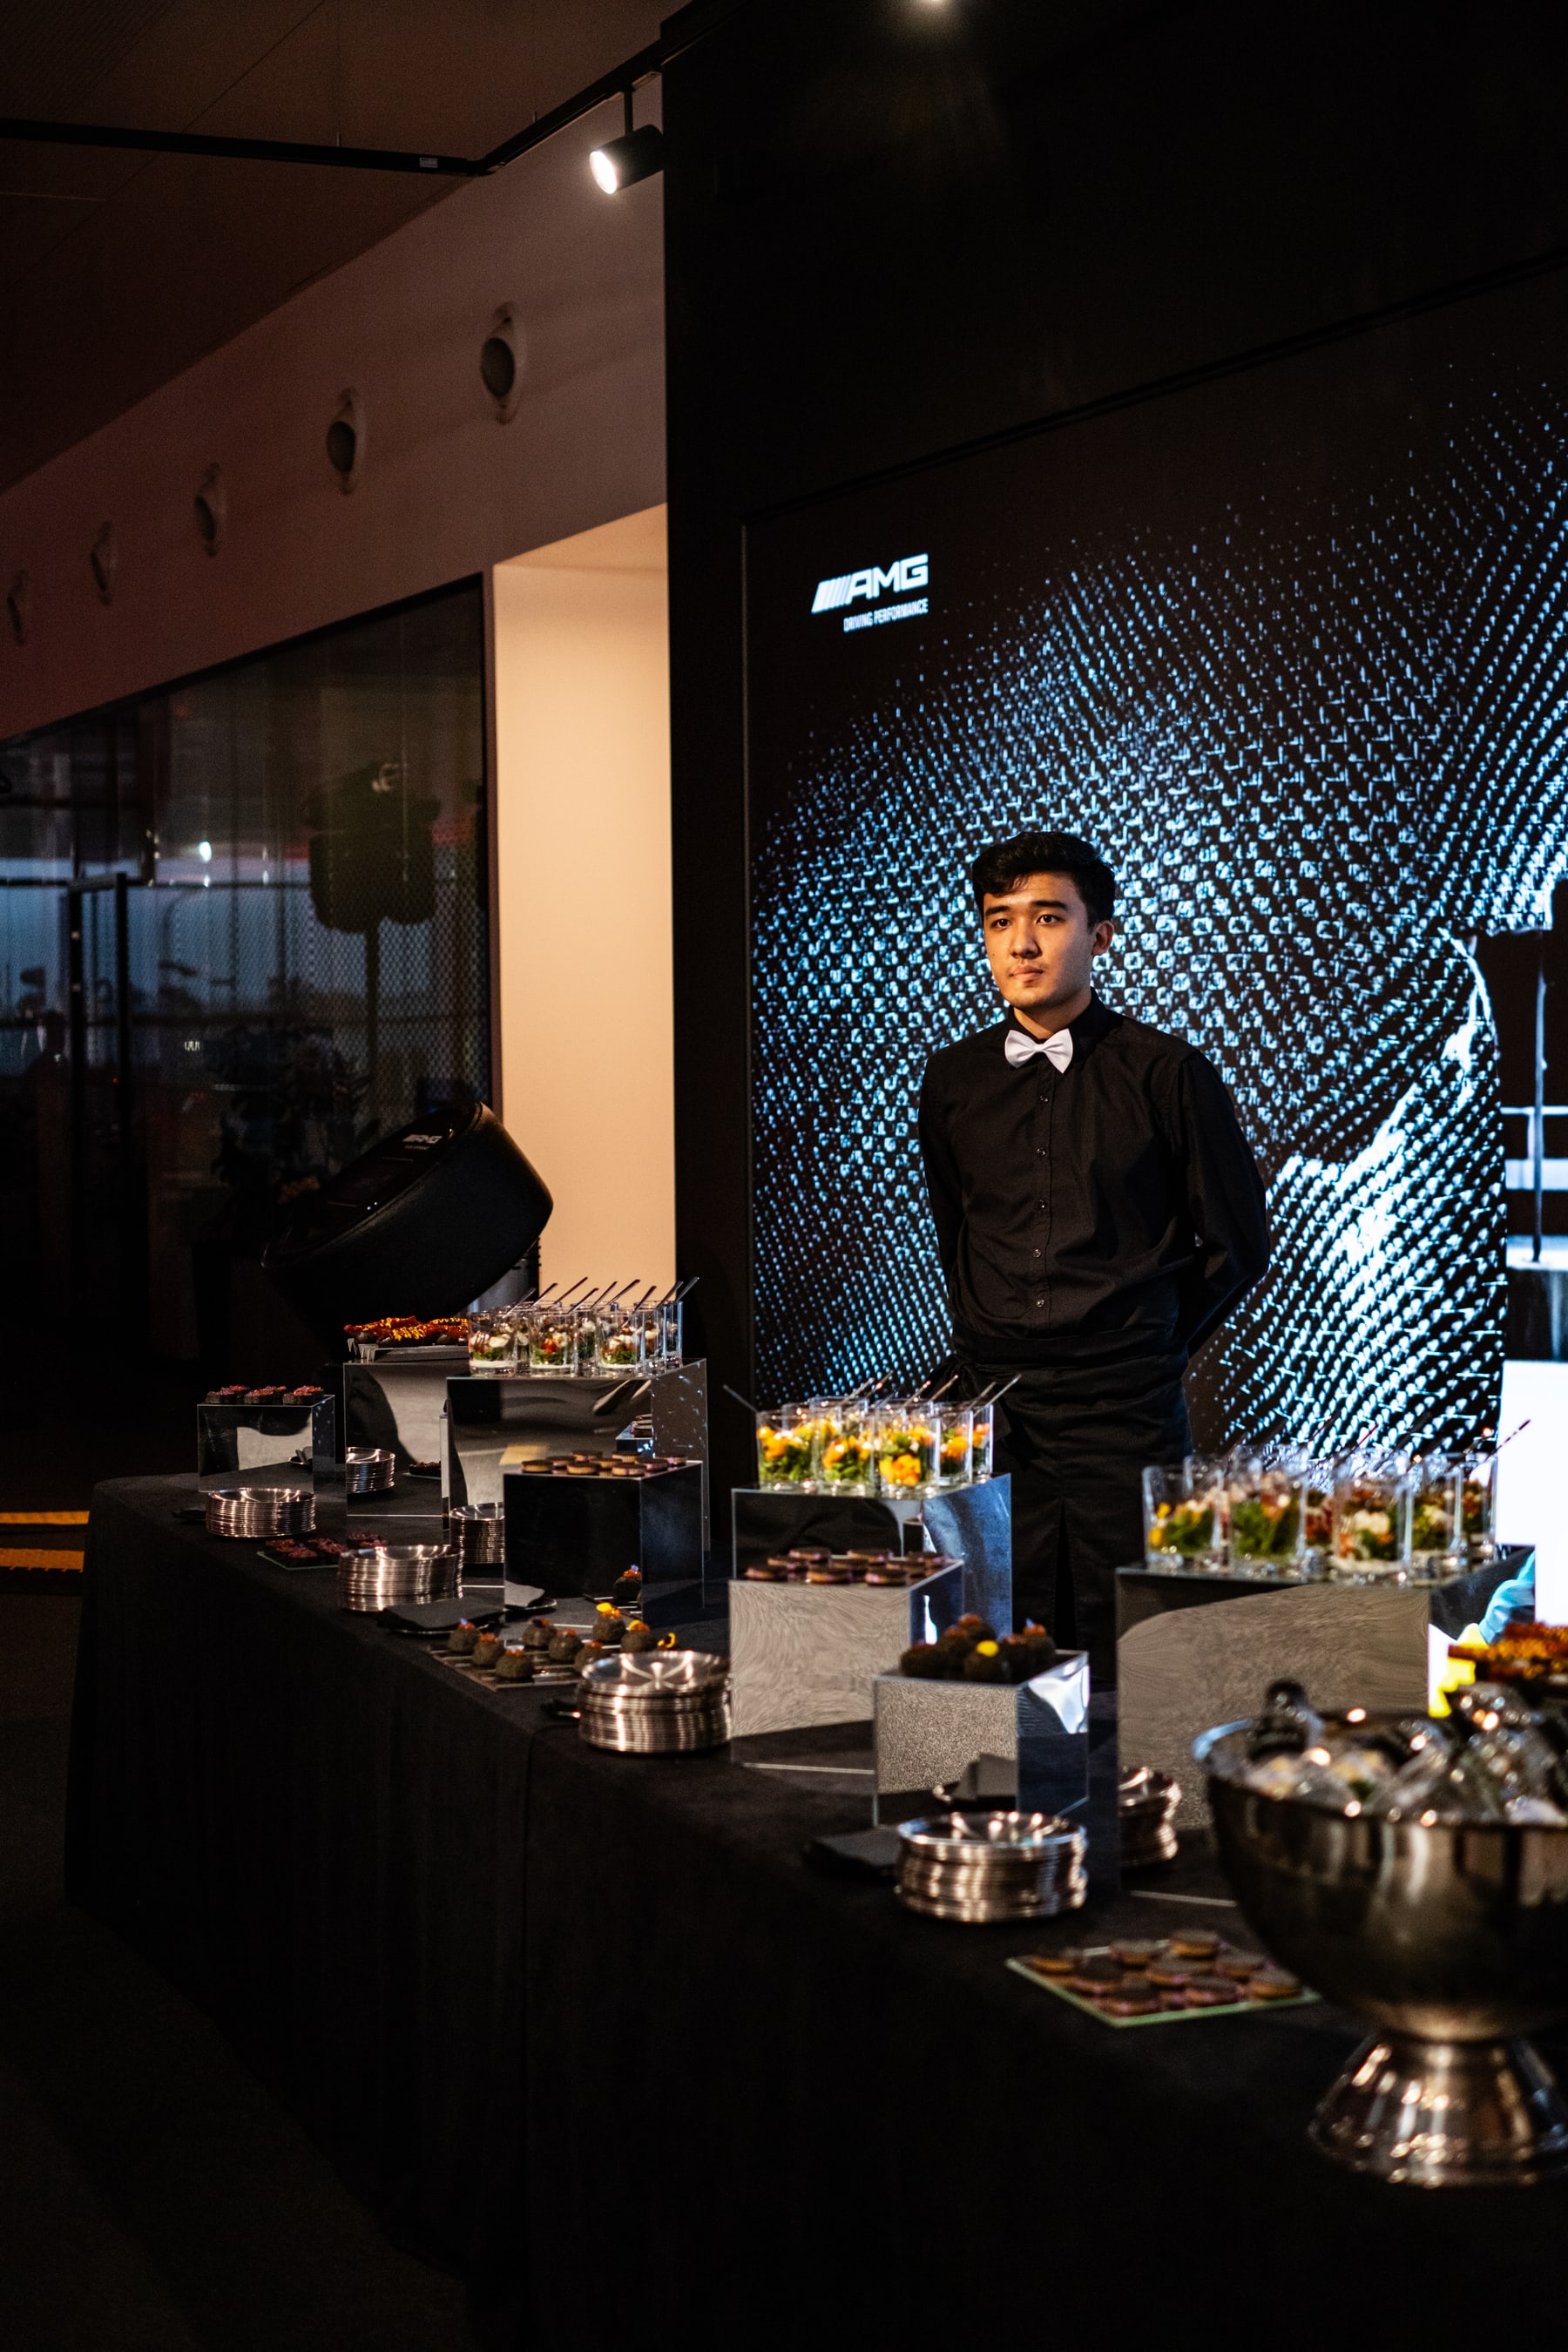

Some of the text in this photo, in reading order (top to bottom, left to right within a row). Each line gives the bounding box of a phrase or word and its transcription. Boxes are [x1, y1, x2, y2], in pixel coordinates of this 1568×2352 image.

[845, 553, 929, 605] AMG
[843, 598, 929, 632] DRIVING PERFORMANCE
